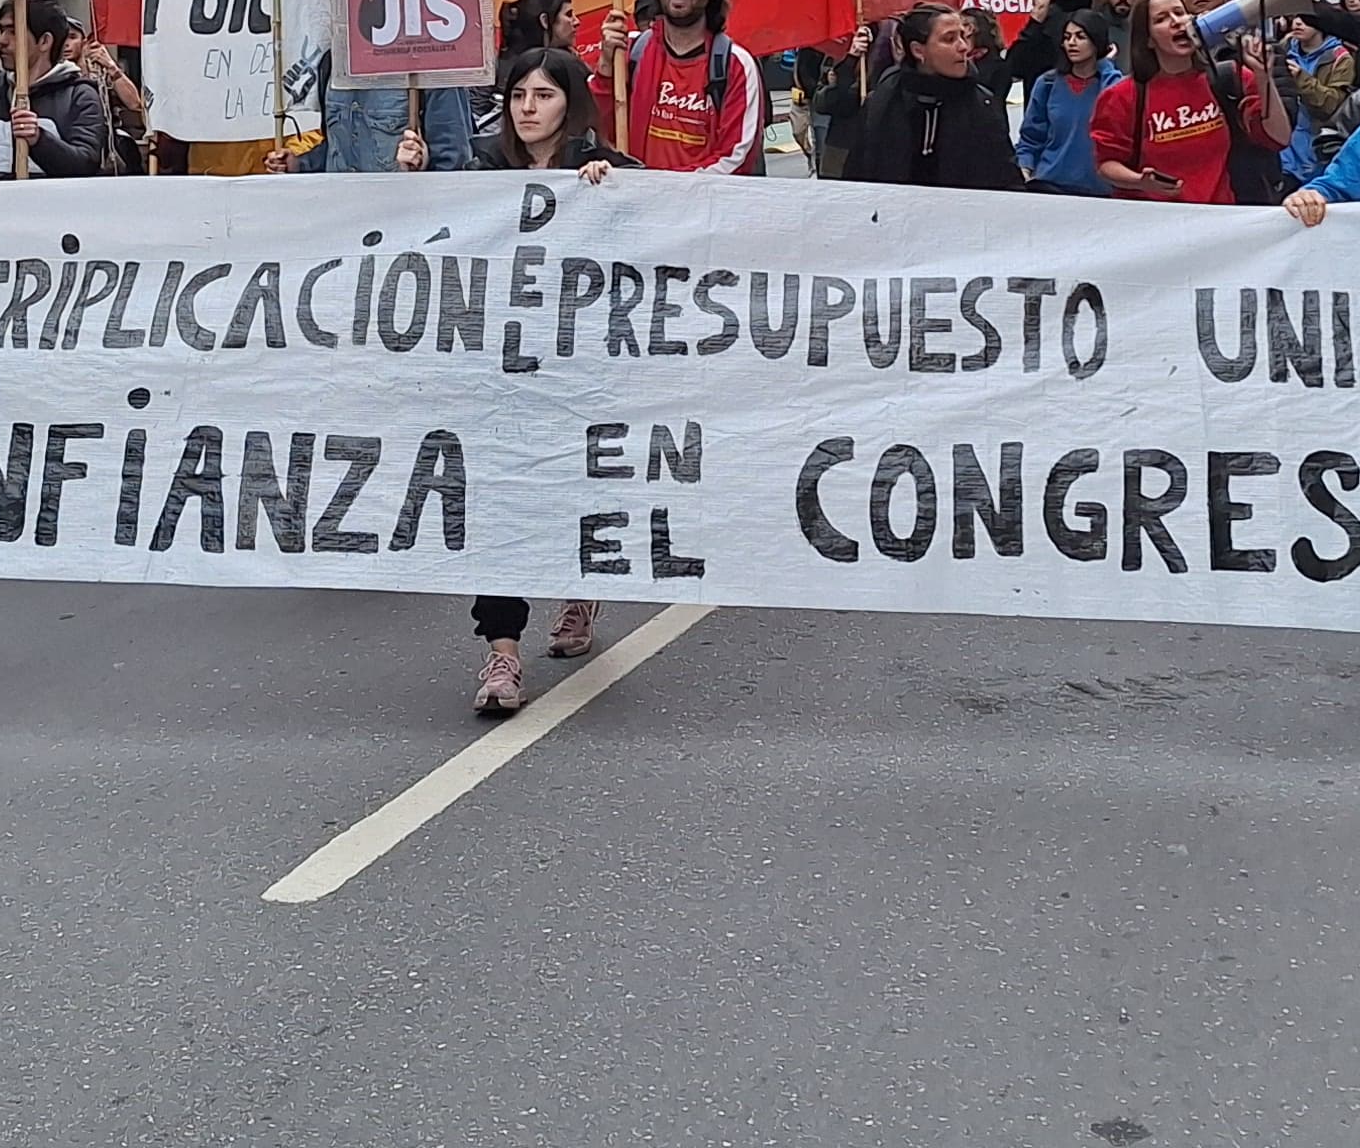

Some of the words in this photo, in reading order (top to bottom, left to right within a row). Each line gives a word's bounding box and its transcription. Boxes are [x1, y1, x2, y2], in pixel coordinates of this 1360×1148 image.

[204, 48, 233, 79] EN
[225, 87, 245, 119] LA
[557, 256, 1108, 380] PRESUPUESTO
[585, 419, 702, 483] EN
[580, 507, 705, 579] EL
